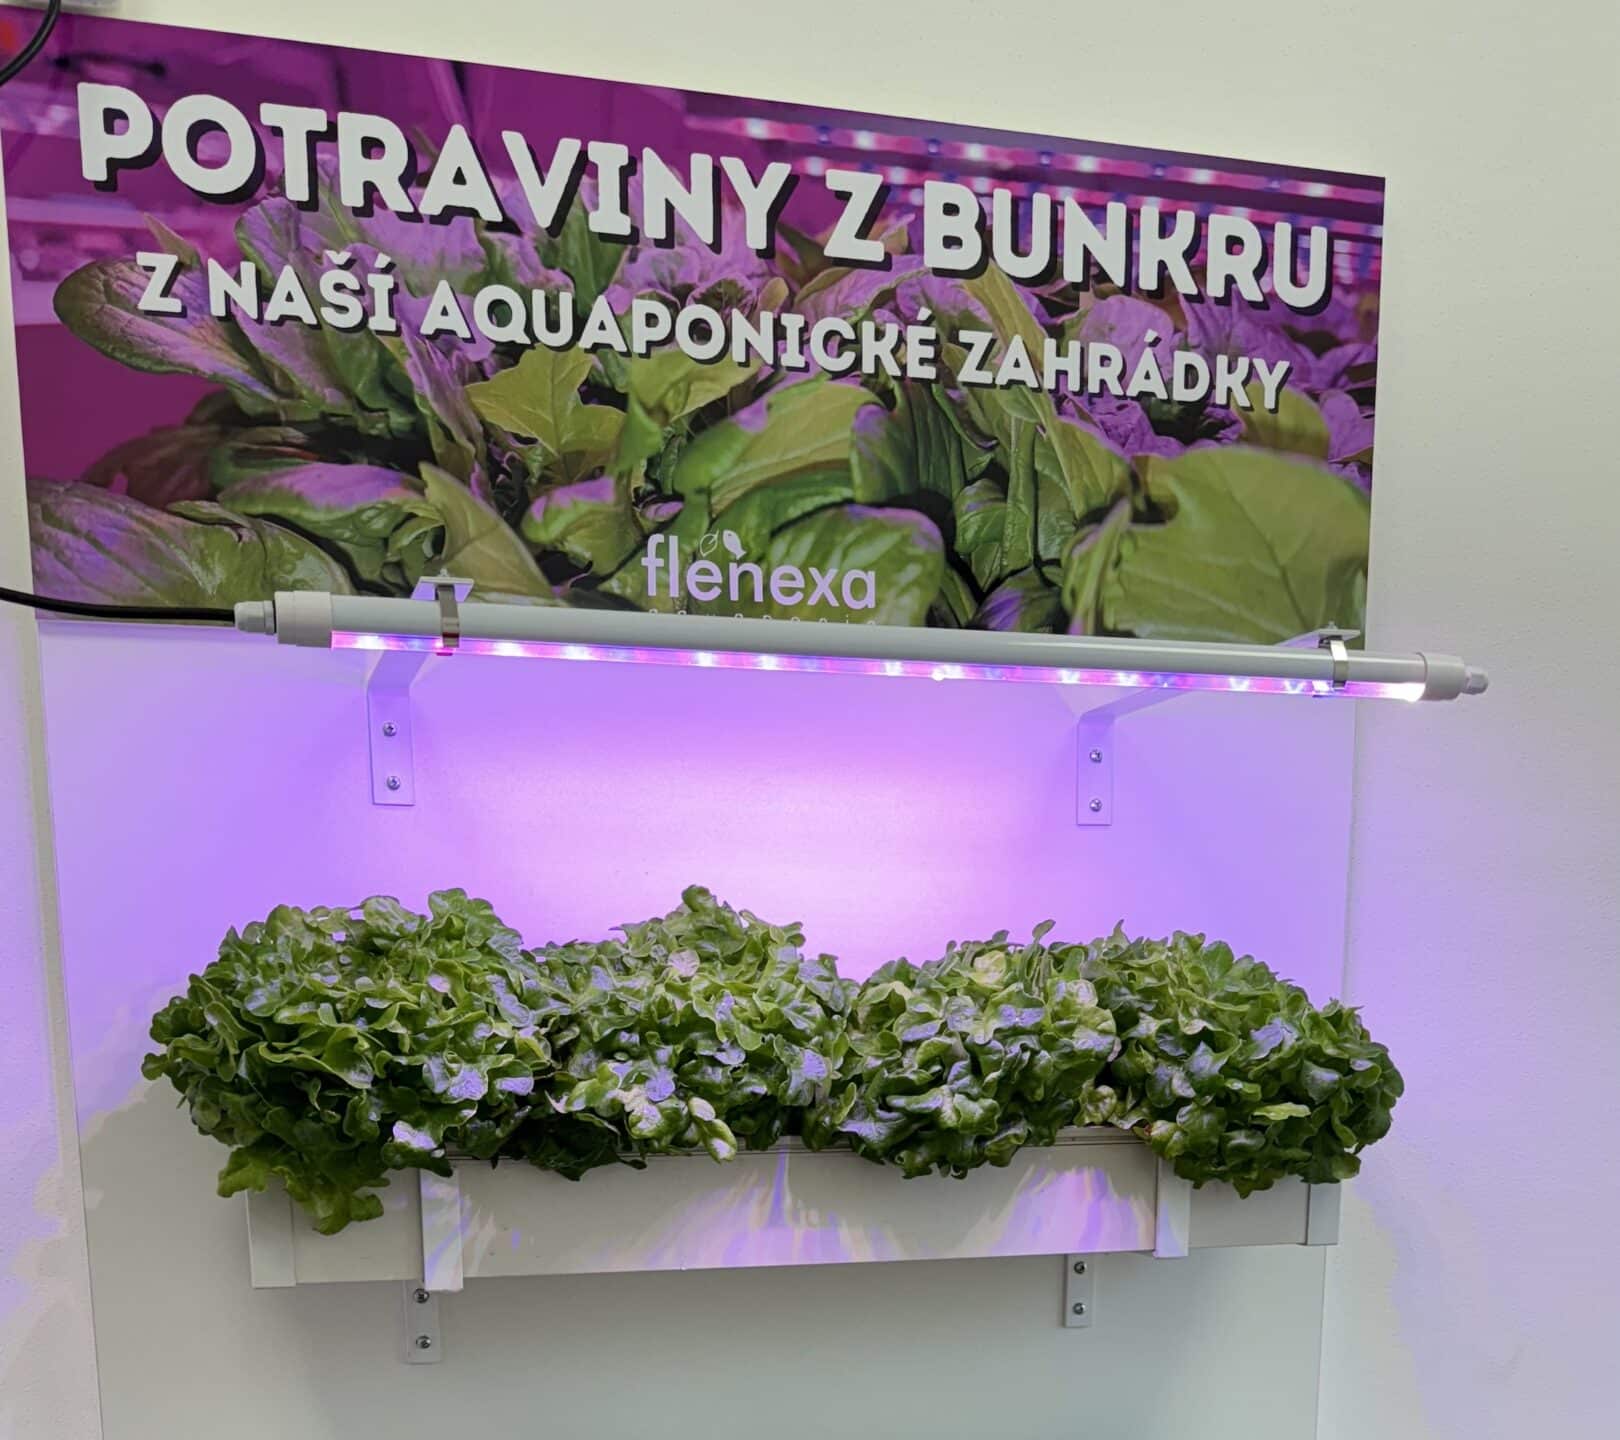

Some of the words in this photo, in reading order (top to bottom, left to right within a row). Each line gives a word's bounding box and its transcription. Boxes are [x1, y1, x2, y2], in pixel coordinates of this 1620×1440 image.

[77, 82, 792, 251] POTRAVINY
[823, 168, 888, 264] Z
[924, 181, 1329, 308] BUNKRU
[136, 252, 184, 314] Z
[208, 250, 397, 332] NAŠÍ
[420, 280, 937, 379] AQUAPONICKÉ
[957, 329, 1290, 409] ZAHRÁDKY
[641, 533, 876, 610] flenexa
